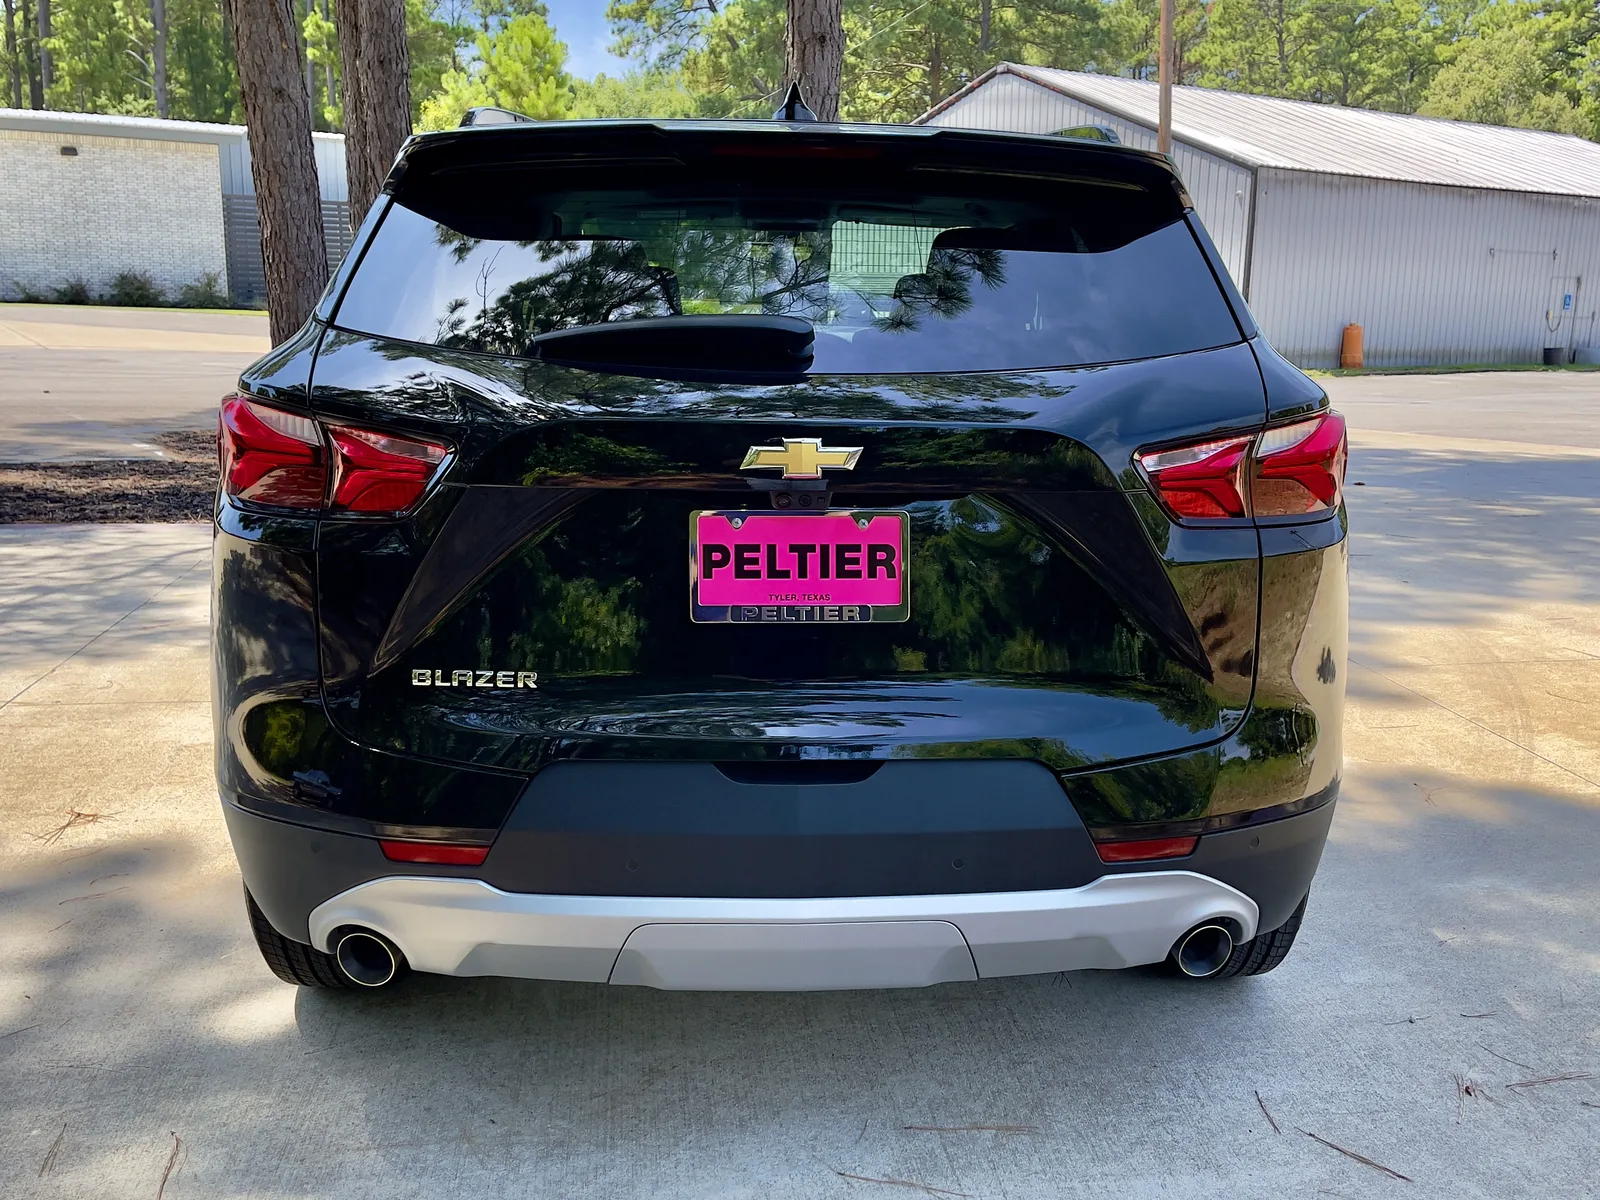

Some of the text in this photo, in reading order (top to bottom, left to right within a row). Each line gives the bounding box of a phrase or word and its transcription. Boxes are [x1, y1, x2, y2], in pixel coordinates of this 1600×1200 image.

[702, 543, 897, 580] PELTIER
[768, 593, 831, 602] TYLER, TEXAS
[740, 605, 861, 622] PELTIER
[411, 668, 538, 688] BLAZER
